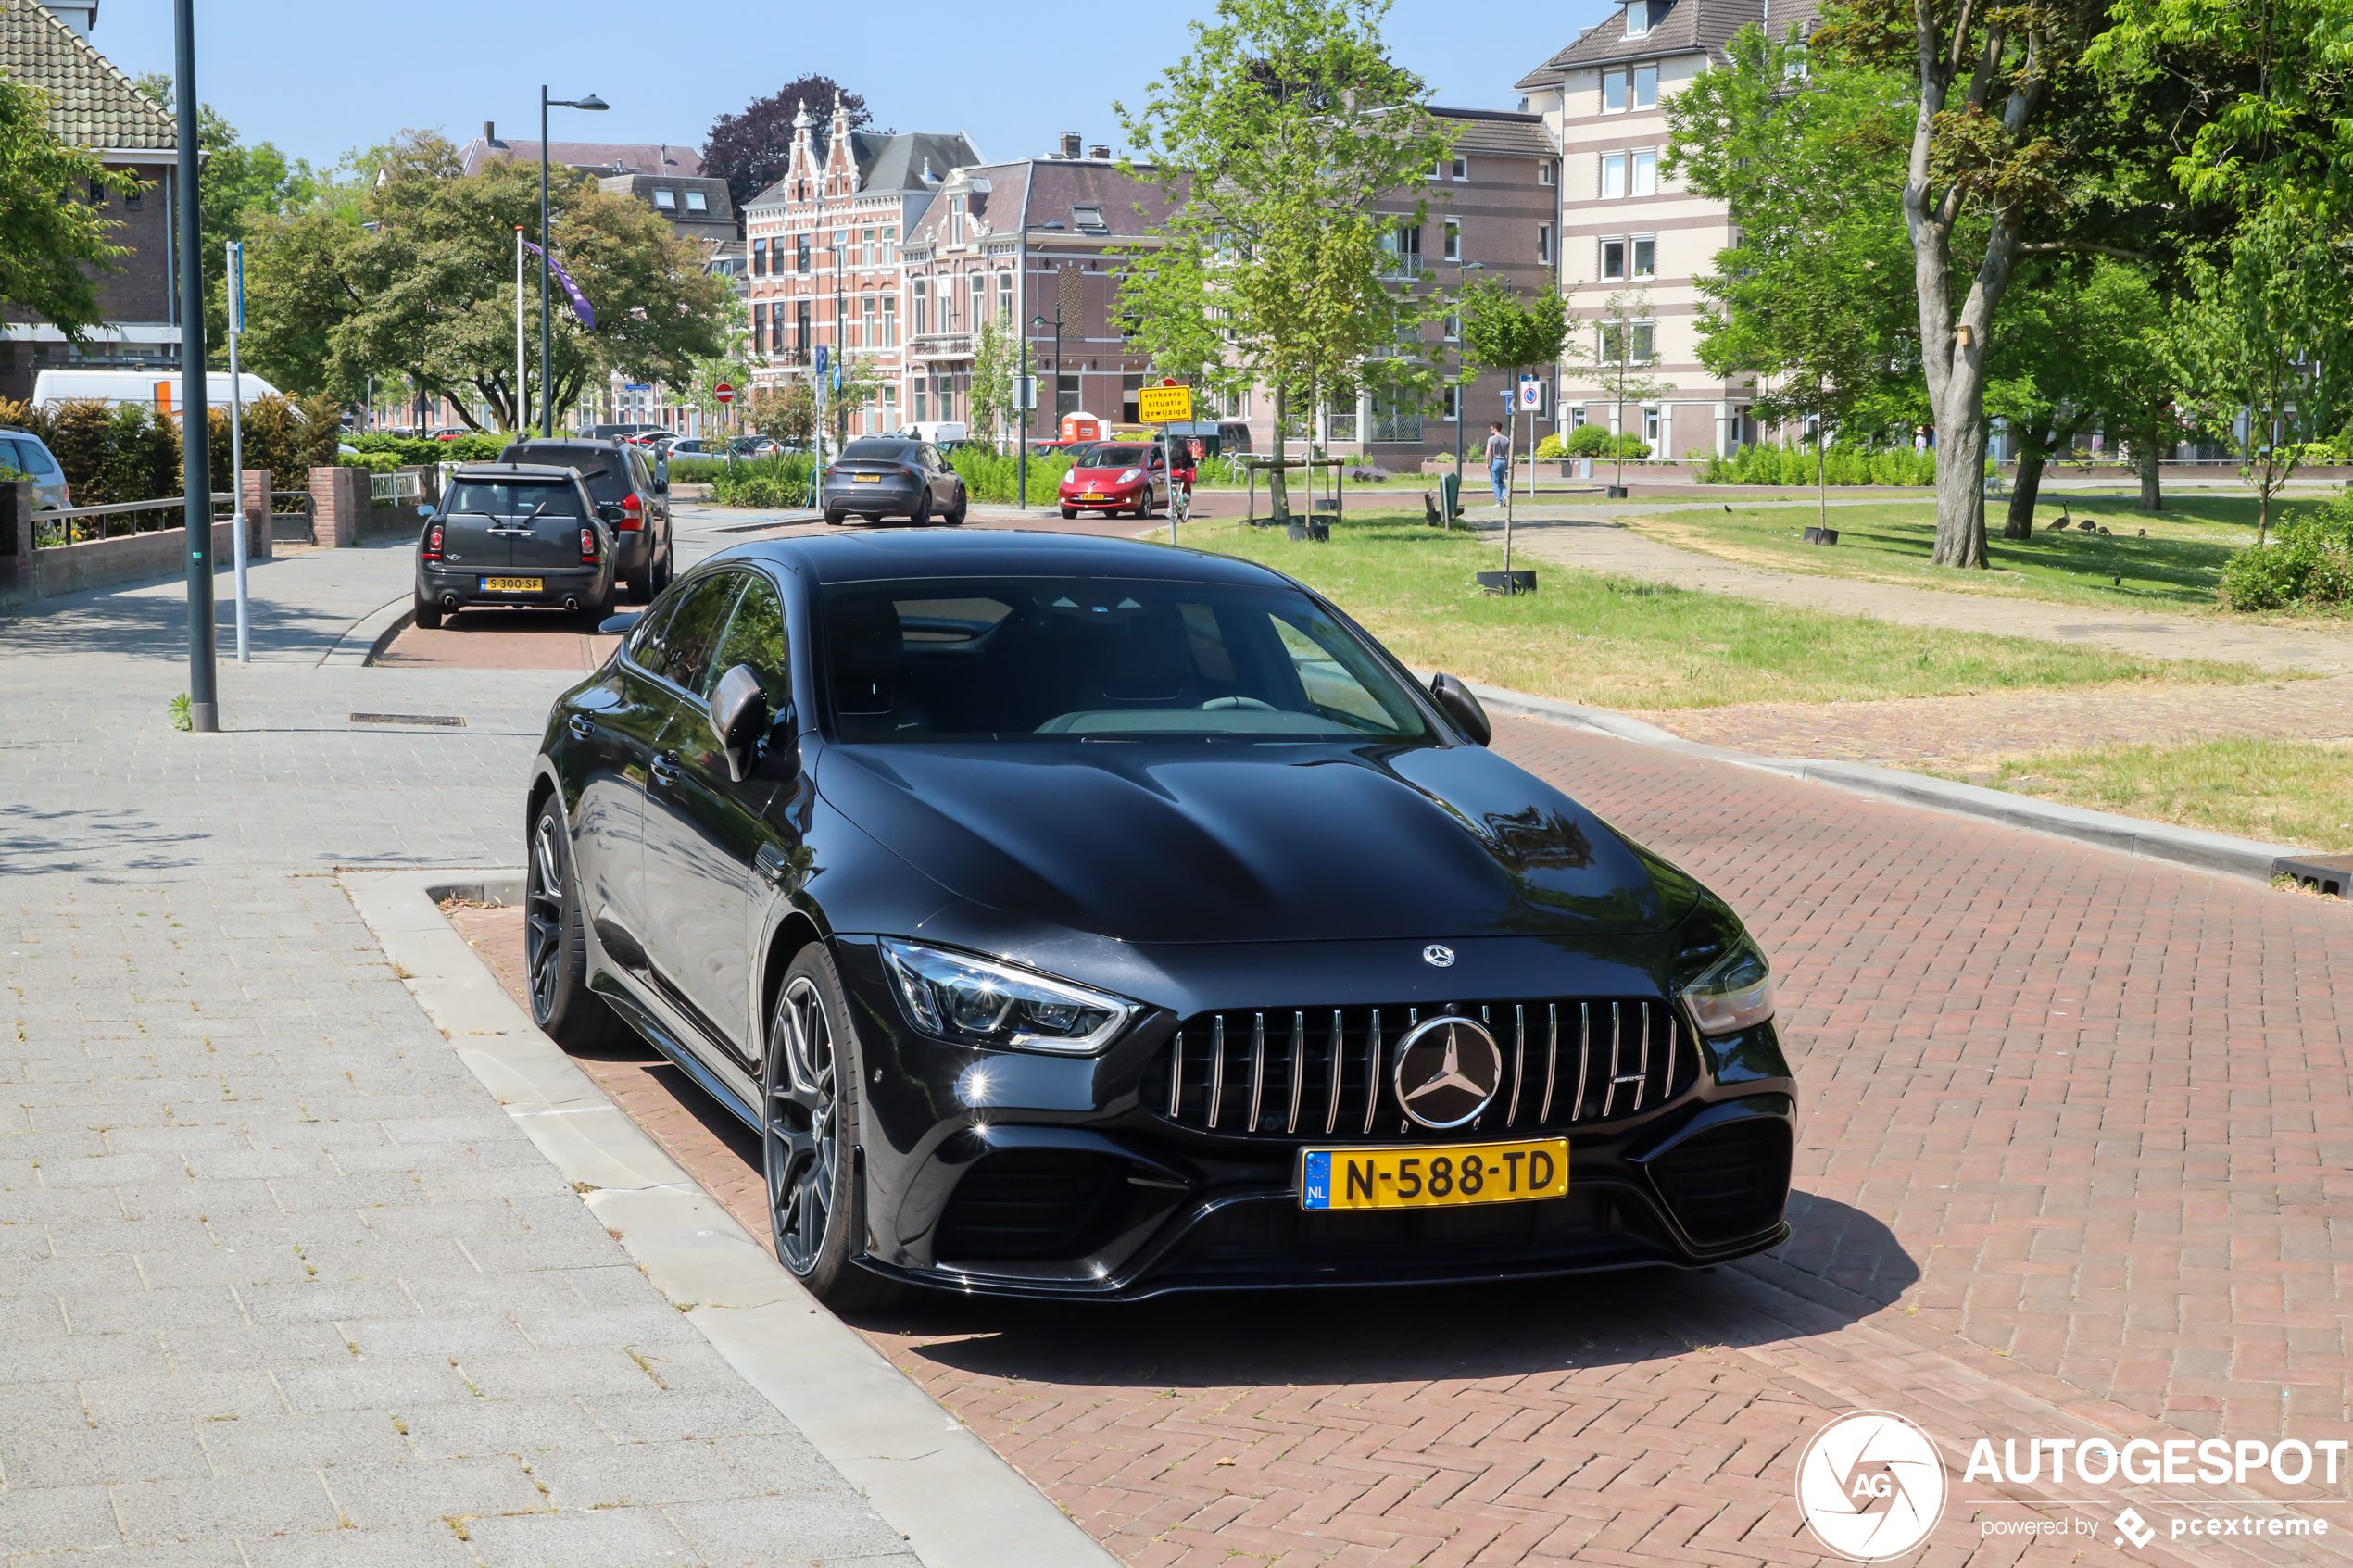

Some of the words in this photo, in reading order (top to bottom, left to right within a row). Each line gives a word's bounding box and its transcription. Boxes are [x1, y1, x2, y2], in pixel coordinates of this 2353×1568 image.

[819, 348, 826, 372] P
[1148, 399, 1182, 408] situatie
[1145, 408, 1187, 418] gewijzigd
[490, 578, 538, 589] S-300-SF
[837, 1102, 848, 1212] MICHELIN
[1346, 1150, 1554, 1199] N-588-TD
[1308, 1186, 1326, 1198] NL
